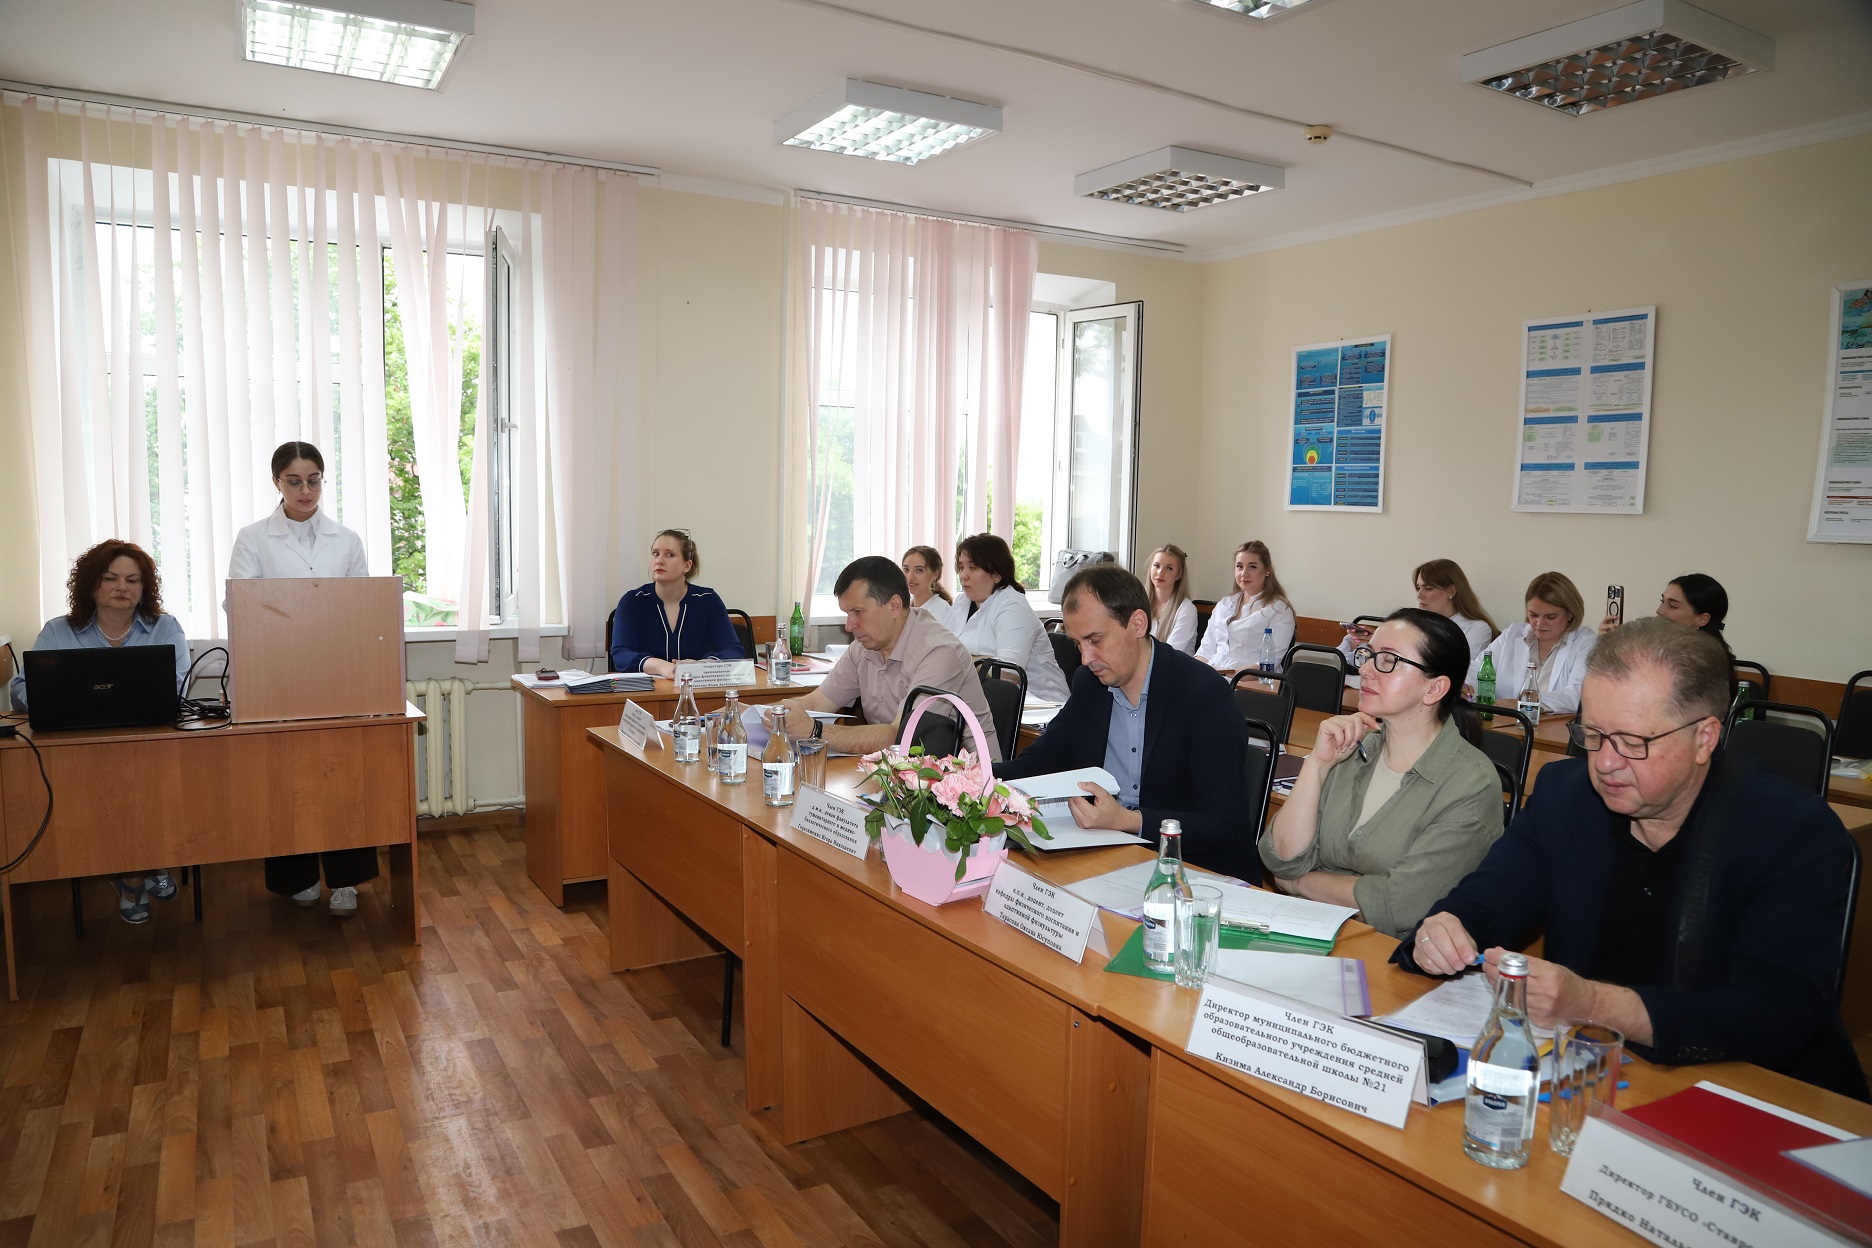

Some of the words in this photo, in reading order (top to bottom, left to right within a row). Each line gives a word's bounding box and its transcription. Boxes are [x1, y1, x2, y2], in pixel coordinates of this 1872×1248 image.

[995, 888, 1015, 903] кафедры
[1015, 899, 1045, 918] физического
[1045, 915, 1075, 935] воспитания
[1032, 882, 1044, 893] Член
[1044, 888, 1056, 899] ГЭК
[1003, 903, 1031, 921] адаптивной
[1031, 916, 1064, 939] физкультуры
[1020, 922, 1037, 937] Оксана
[1203, 999, 1251, 1022] Директор
[1252, 1015, 1338, 1049] муниципального
[1340, 1040, 1410, 1073] бюджетного
[1284, 1011, 1309, 1027] Член
[1312, 1018, 1336, 1035] ГЭК
[1203, 1012, 1289, 1047] образовательного
[1291, 1041, 1355, 1069] учреждения
[1358, 1064, 1404, 1085] средней
[1211, 1026, 1320, 1070] общеобразовательной
[1322, 1064, 1360, 1084] школы
[1362, 1076, 1387, 1093] №21
[1215, 1052, 1252, 1072] Кизима
[1254, 1066, 1308, 1094] Александр
[1310, 1085, 1368, 1114] Борисович
[1588, 1189, 1636, 1222] Прядко
[1598, 1163, 1656, 1200] Директор
[1657, 1195, 1699, 1223] ГБУСО
[1692, 1177, 1726, 1204] Член
[1729, 1198, 1762, 1222] ГЭК
